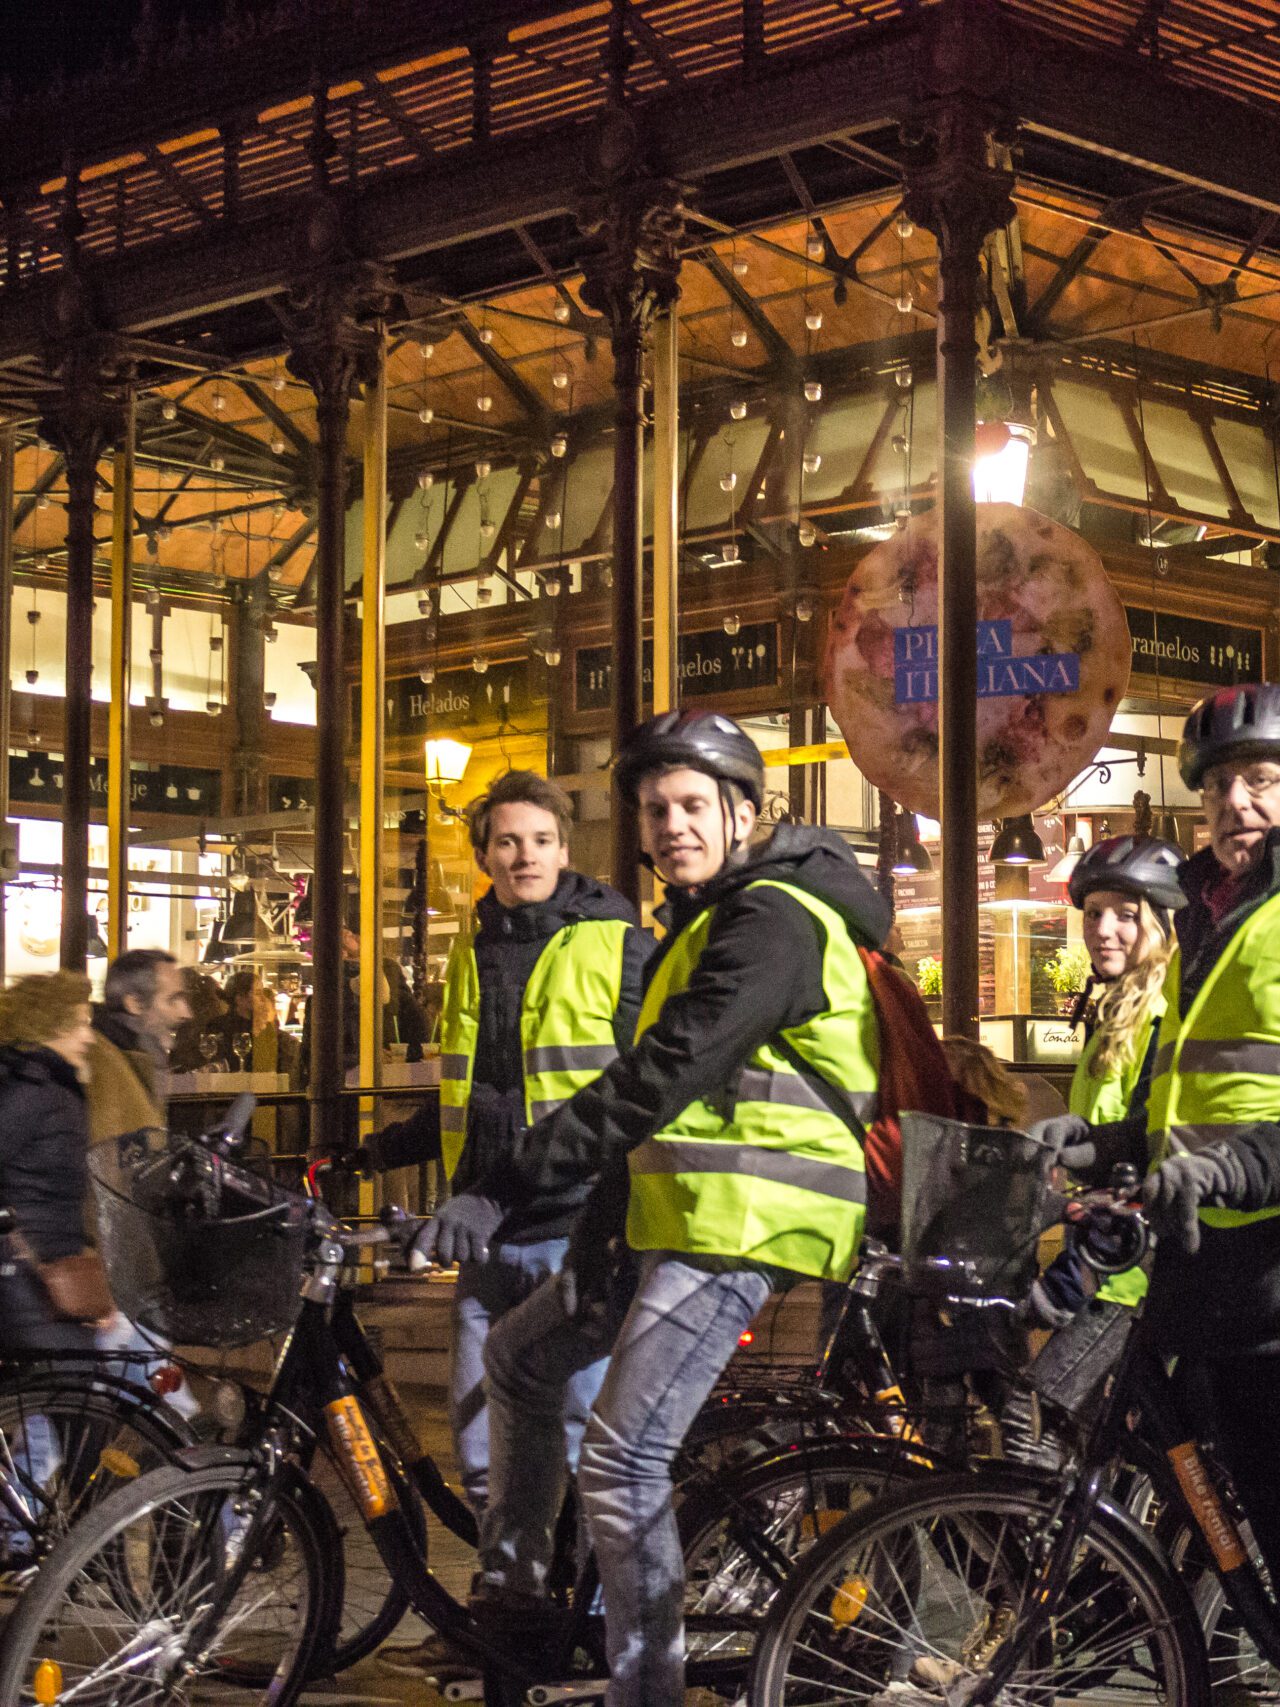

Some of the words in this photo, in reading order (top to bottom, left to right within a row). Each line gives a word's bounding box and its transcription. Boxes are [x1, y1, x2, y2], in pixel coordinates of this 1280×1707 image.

[904, 627, 1004, 660] PIA
[1131, 636, 1200, 663] ramelos
[904, 660, 1073, 698] ITIANA
[409, 689, 470, 718] Helados
[88, 773, 148, 802] Meje
[1043, 1026, 1080, 1044] tonda
